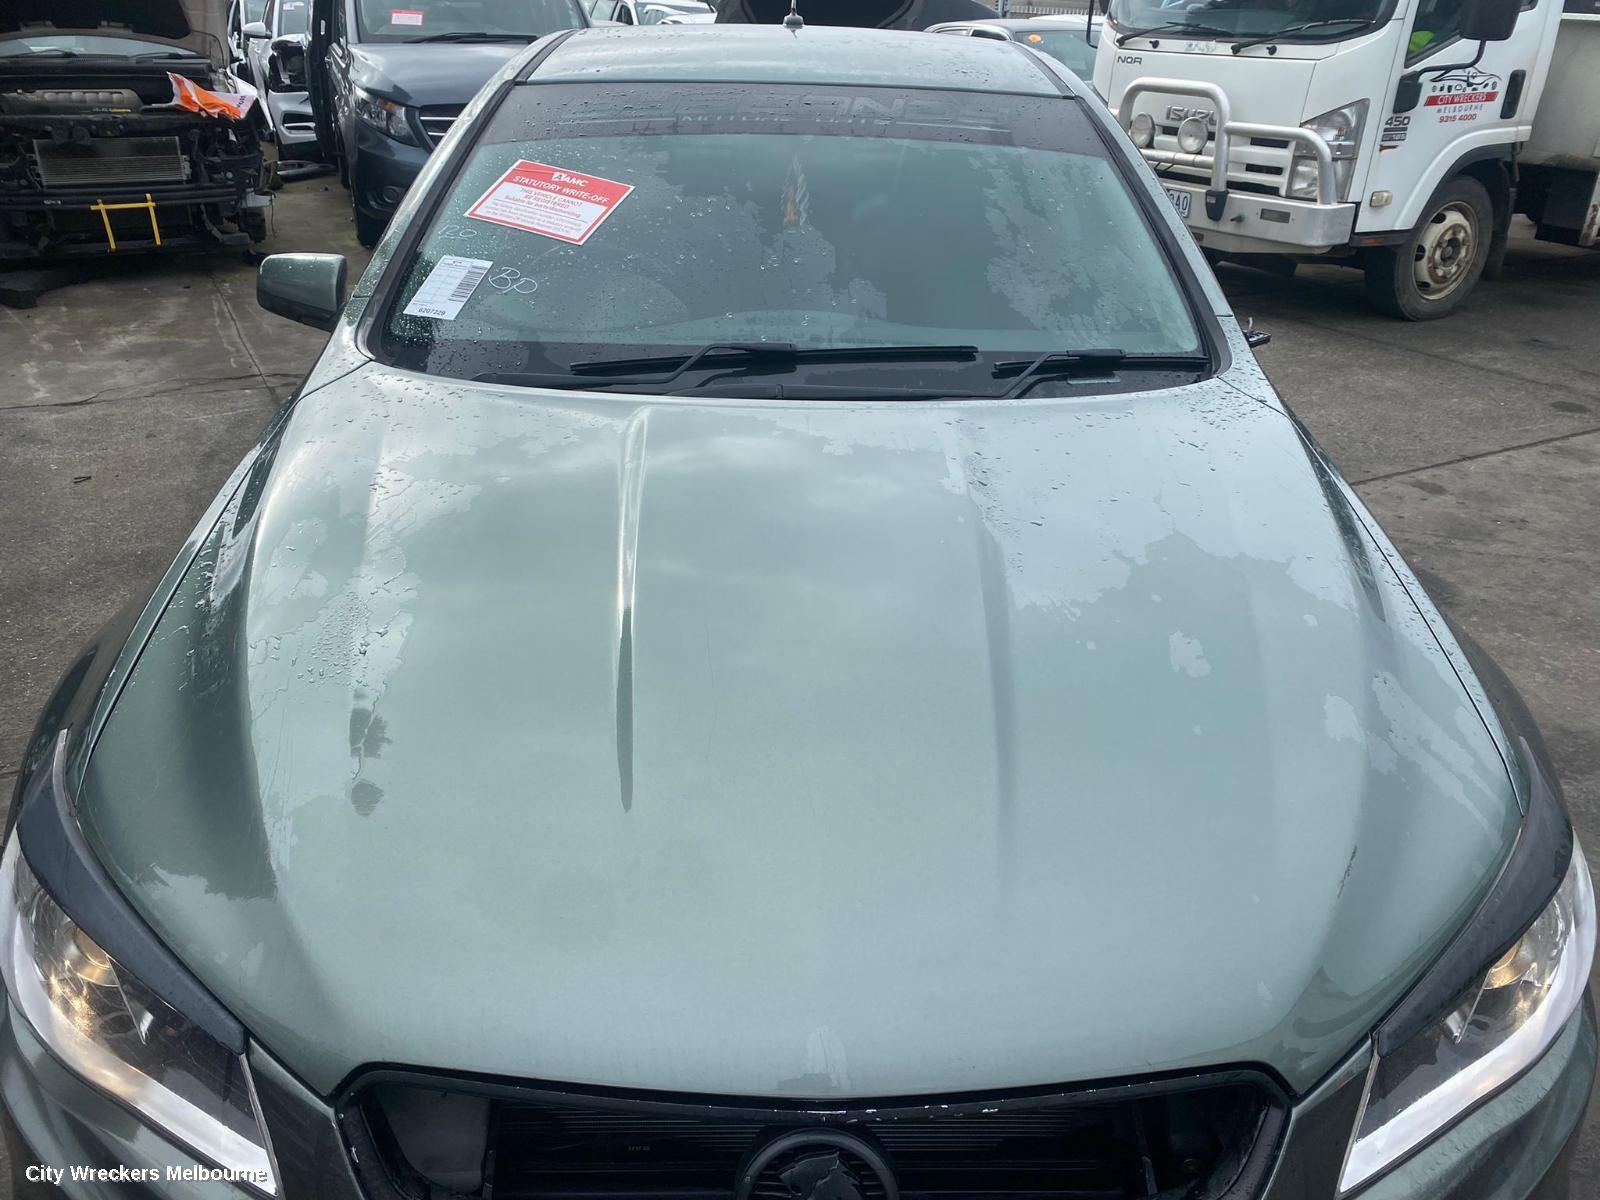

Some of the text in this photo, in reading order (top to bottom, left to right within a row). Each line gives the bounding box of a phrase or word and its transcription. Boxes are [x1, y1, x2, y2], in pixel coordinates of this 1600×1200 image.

[1117, 55, 1142, 65] NQR
[1438, 93, 1487, 105] CITY WRECKERS
[1436, 104, 1484, 114] MELBOURNE
[1384, 116, 1411, 126] 450
[1439, 113, 1477, 123] 9315 4000
[512, 175, 609, 204] STATUTORY WRITE-OFF
[556, 195, 583, 207] CANNOT
